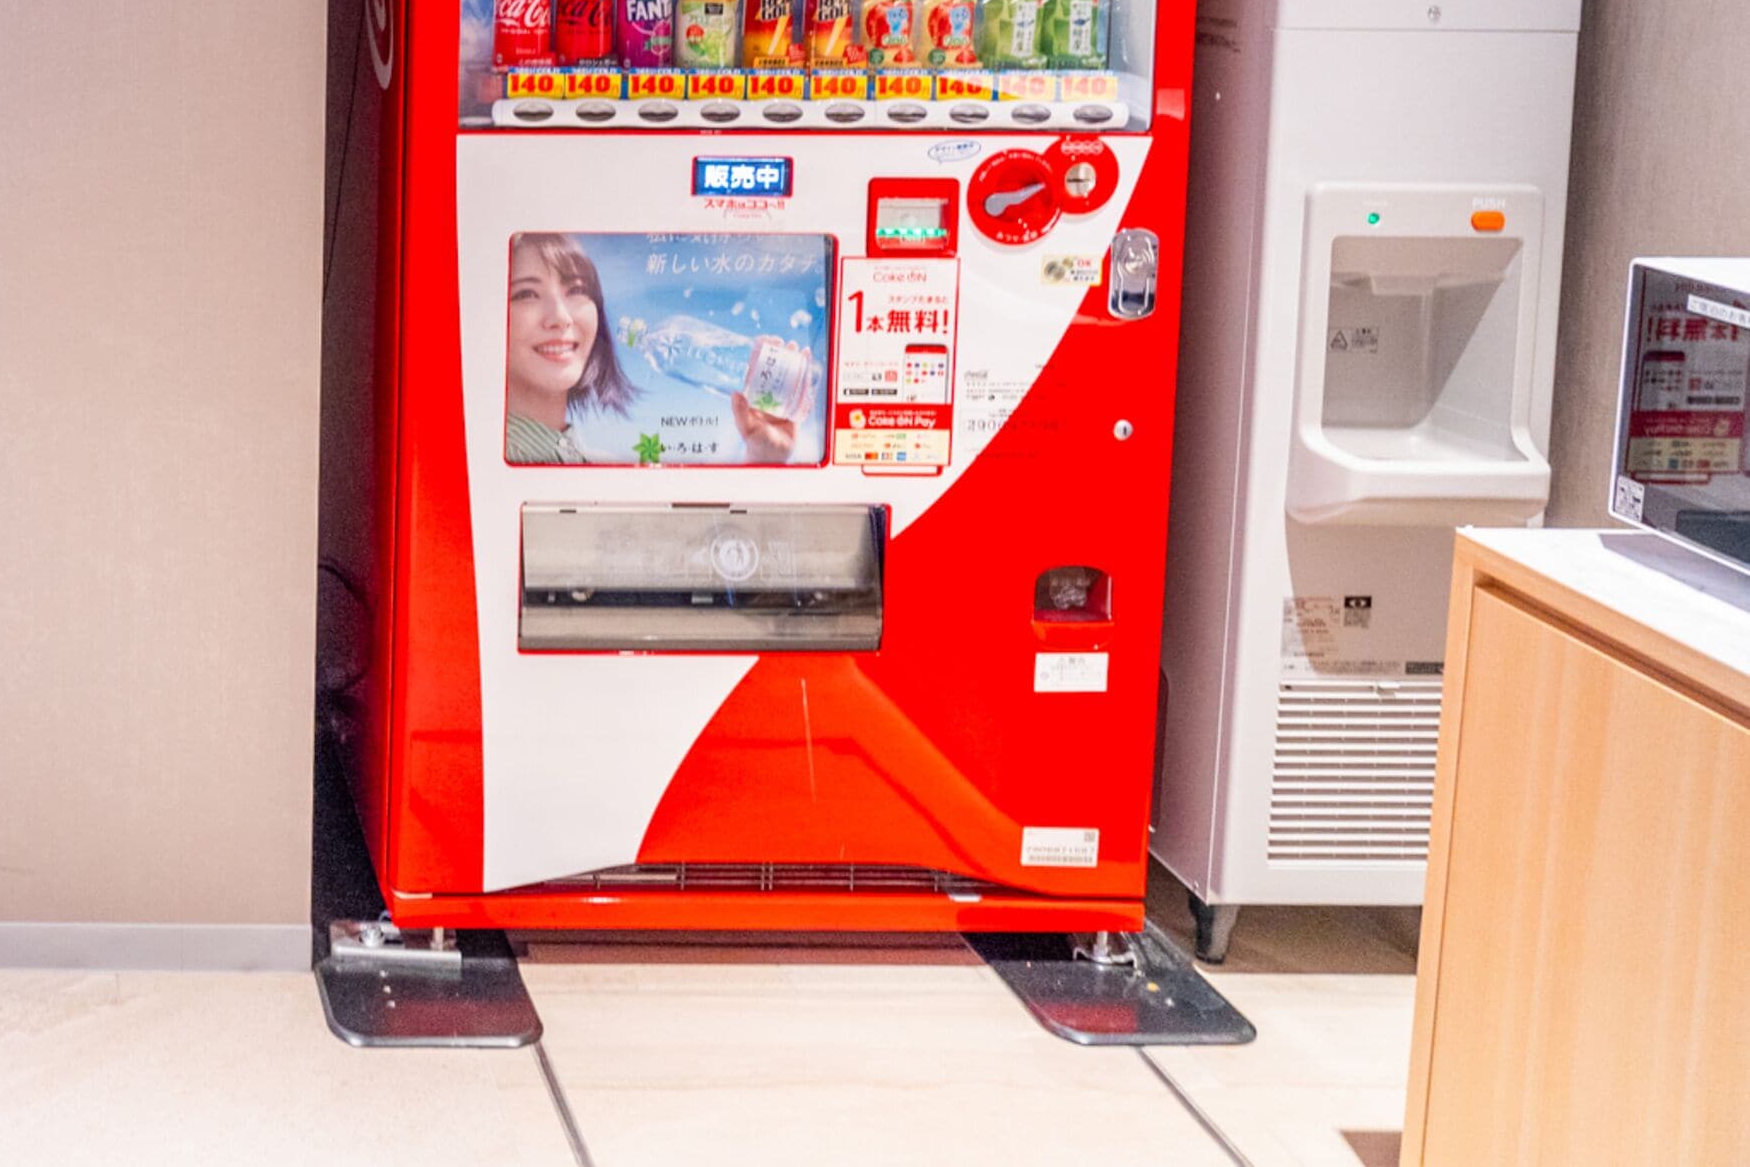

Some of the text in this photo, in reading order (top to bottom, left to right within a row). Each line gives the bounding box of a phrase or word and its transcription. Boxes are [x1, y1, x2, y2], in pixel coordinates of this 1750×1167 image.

[704, 164, 781, 190] 販売中
[1472, 195, 1506, 213] PUSH
[848, 290, 949, 334] 1本無料!
